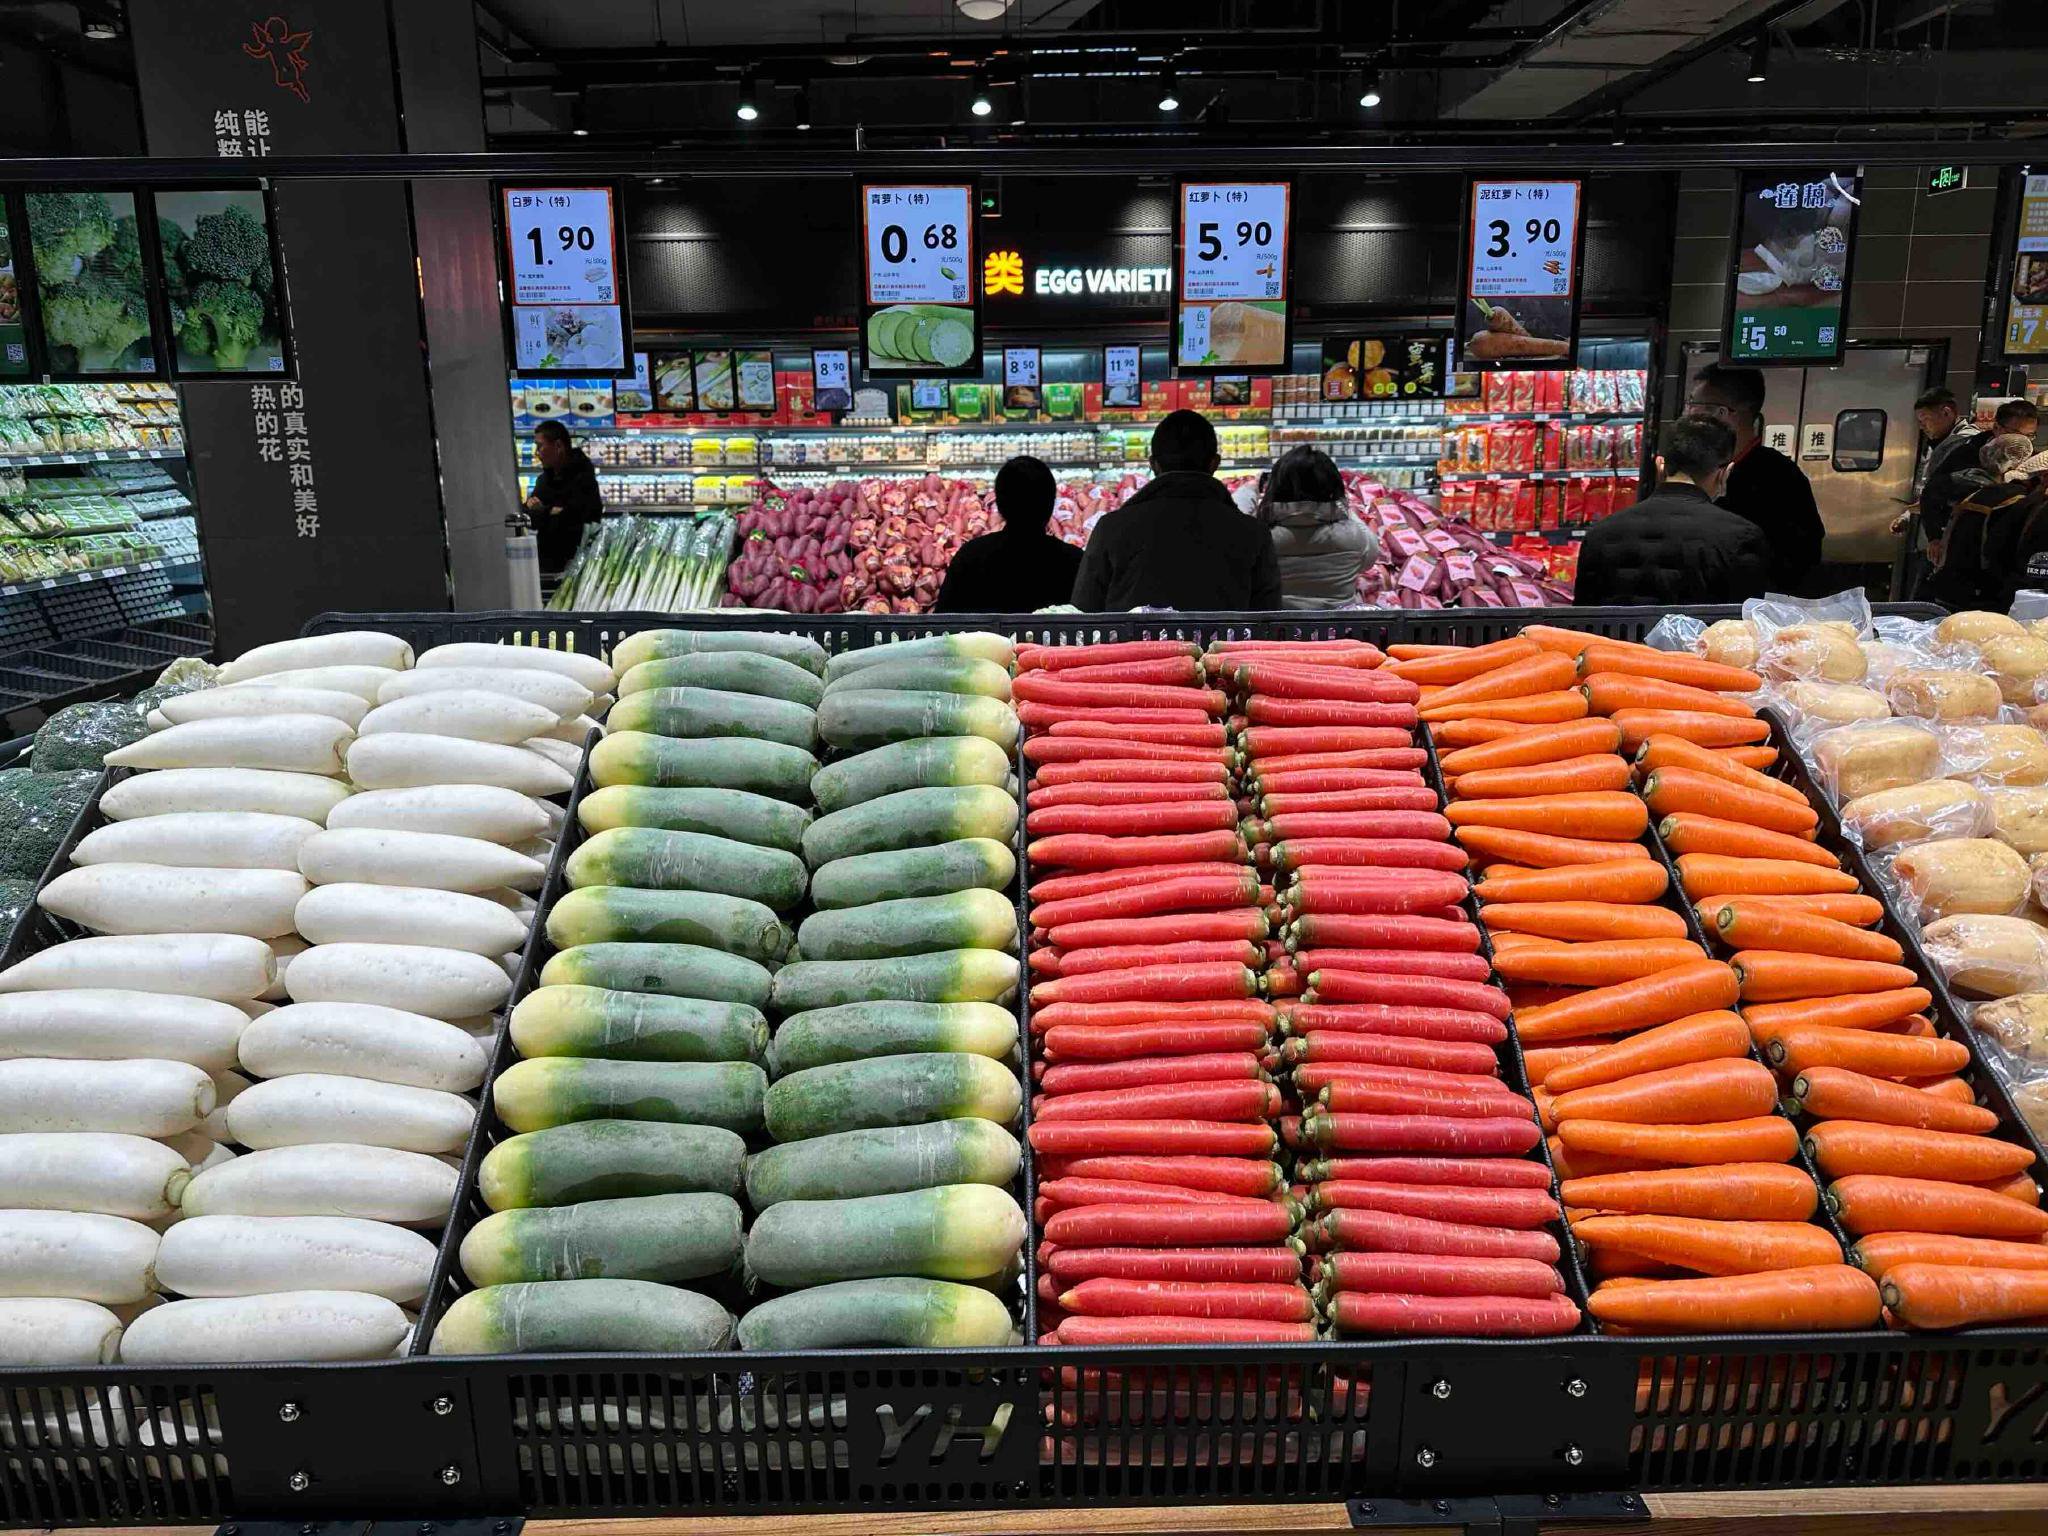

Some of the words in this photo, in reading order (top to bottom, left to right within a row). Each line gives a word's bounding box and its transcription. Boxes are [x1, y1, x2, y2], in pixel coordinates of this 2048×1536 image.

[984, 250, 1024, 295] 类
[1035, 268, 1083, 294] EGG
[250, 384, 284, 463] 热的花
[1772, 431, 1787, 447] 推
[1811, 431, 1826, 447] 推
[279, 383, 321, 538] 的真实和美好
[875, 1402, 1014, 1469] YH
